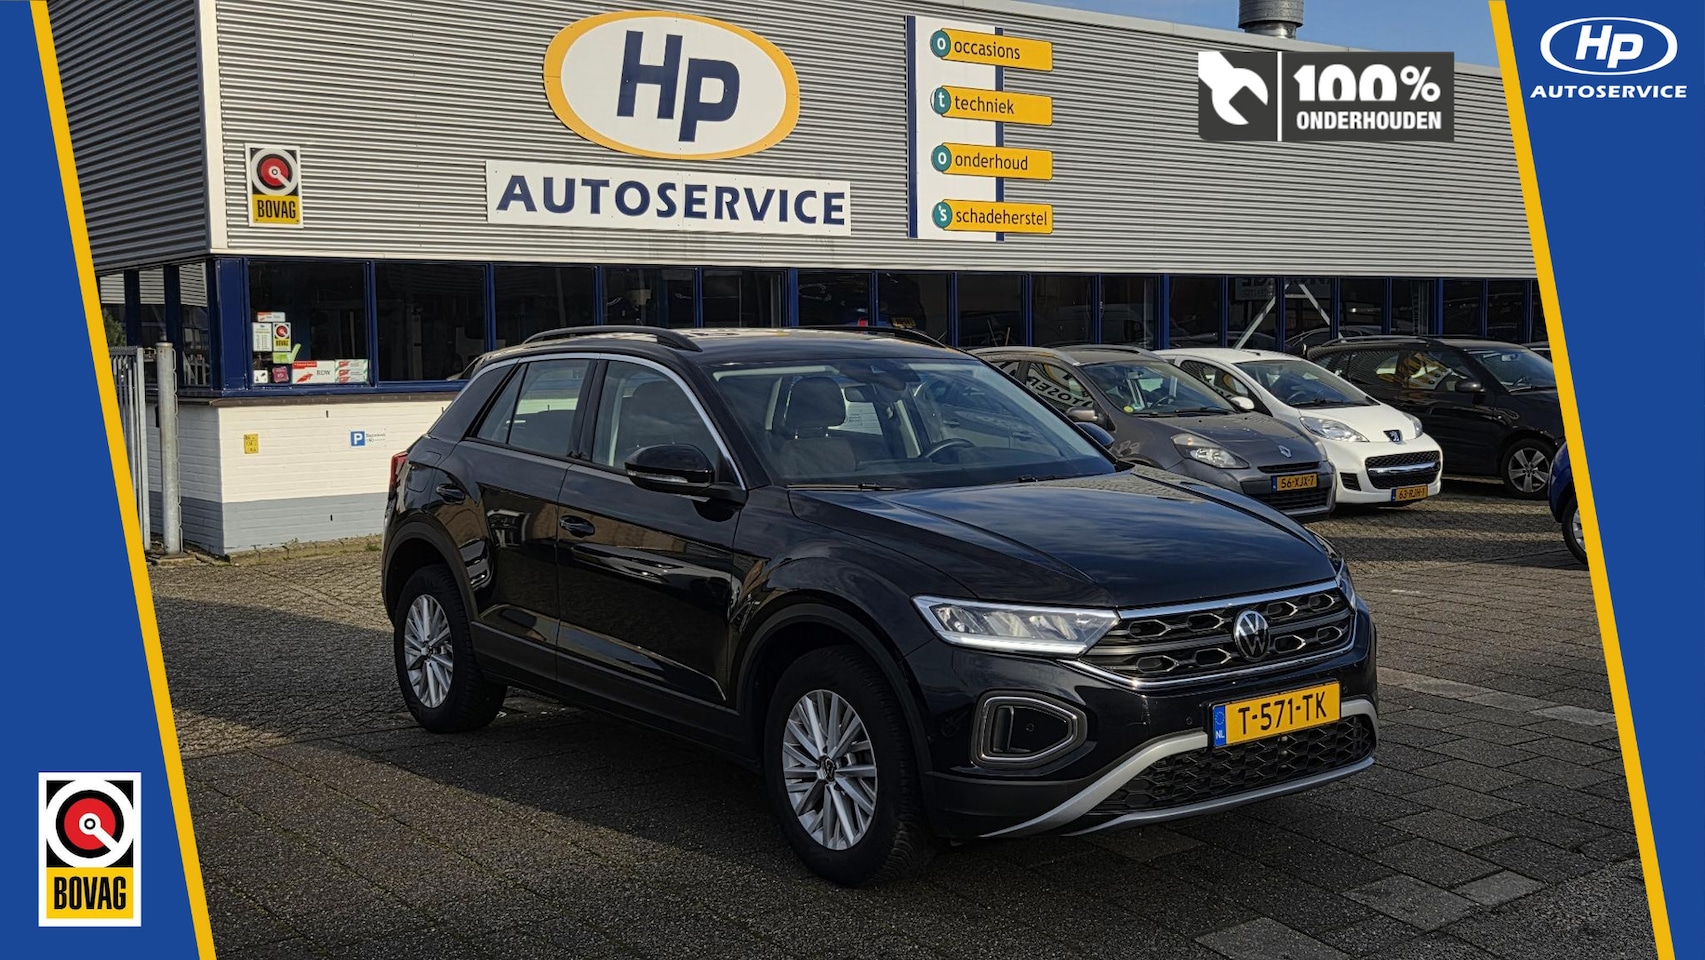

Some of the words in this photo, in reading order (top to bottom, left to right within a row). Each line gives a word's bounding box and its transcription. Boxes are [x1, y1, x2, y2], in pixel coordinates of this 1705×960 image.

[954, 41, 1020, 60] occasions
[955, 95, 1014, 115] techniek
[955, 152, 1028, 171] onderhoud
[257, 199, 296, 219] BOVAG
[496, 175, 845, 226] AUTOSERVICE
[955, 207, 1048, 226] schadeherstel
[354, 433, 363, 445] P
[1280, 475, 1314, 489] 56-XJX-7
[1215, 731, 1225, 740] NL
[1238, 691, 1327, 735] T-571-TK
